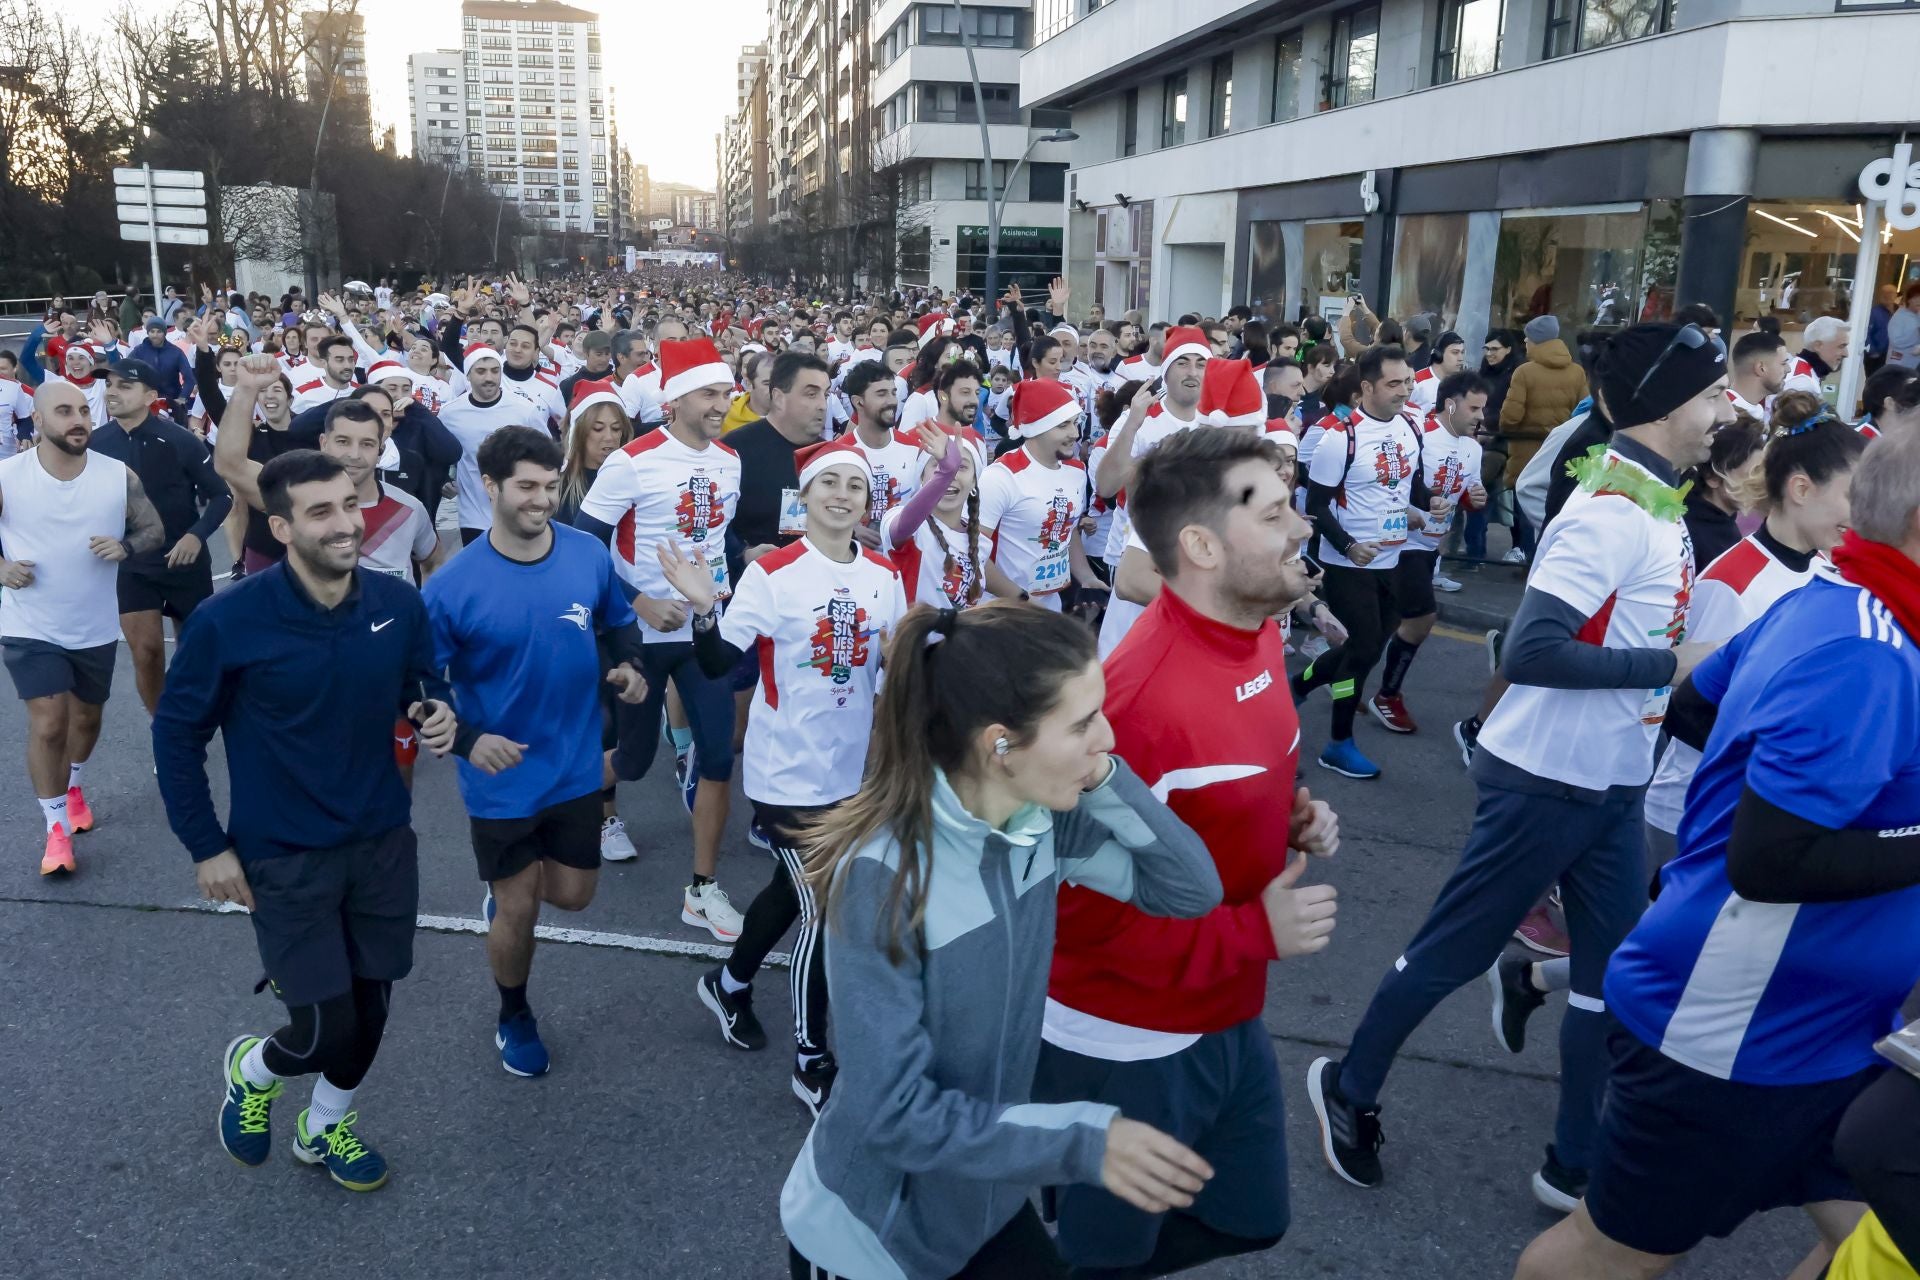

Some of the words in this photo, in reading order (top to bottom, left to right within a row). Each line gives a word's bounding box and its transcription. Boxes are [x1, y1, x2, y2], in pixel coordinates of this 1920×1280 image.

[1001, 228, 1038, 237] Asistencial
[1388, 461, 1401, 471] VES
[1388, 471, 1401, 480] TRE
[694, 494, 711, 506] SIL
[872, 490, 888, 500] SIL
[872, 500, 888, 509] VES
[694, 505, 711, 517] VES
[693, 516, 710, 529] TRE
[1035, 558, 1067, 580] 2210
[832, 608, 855, 625] SAN
[834, 621, 854, 638] SIL
[833, 636, 855, 650] VES
[832, 650, 853, 668] TRE
